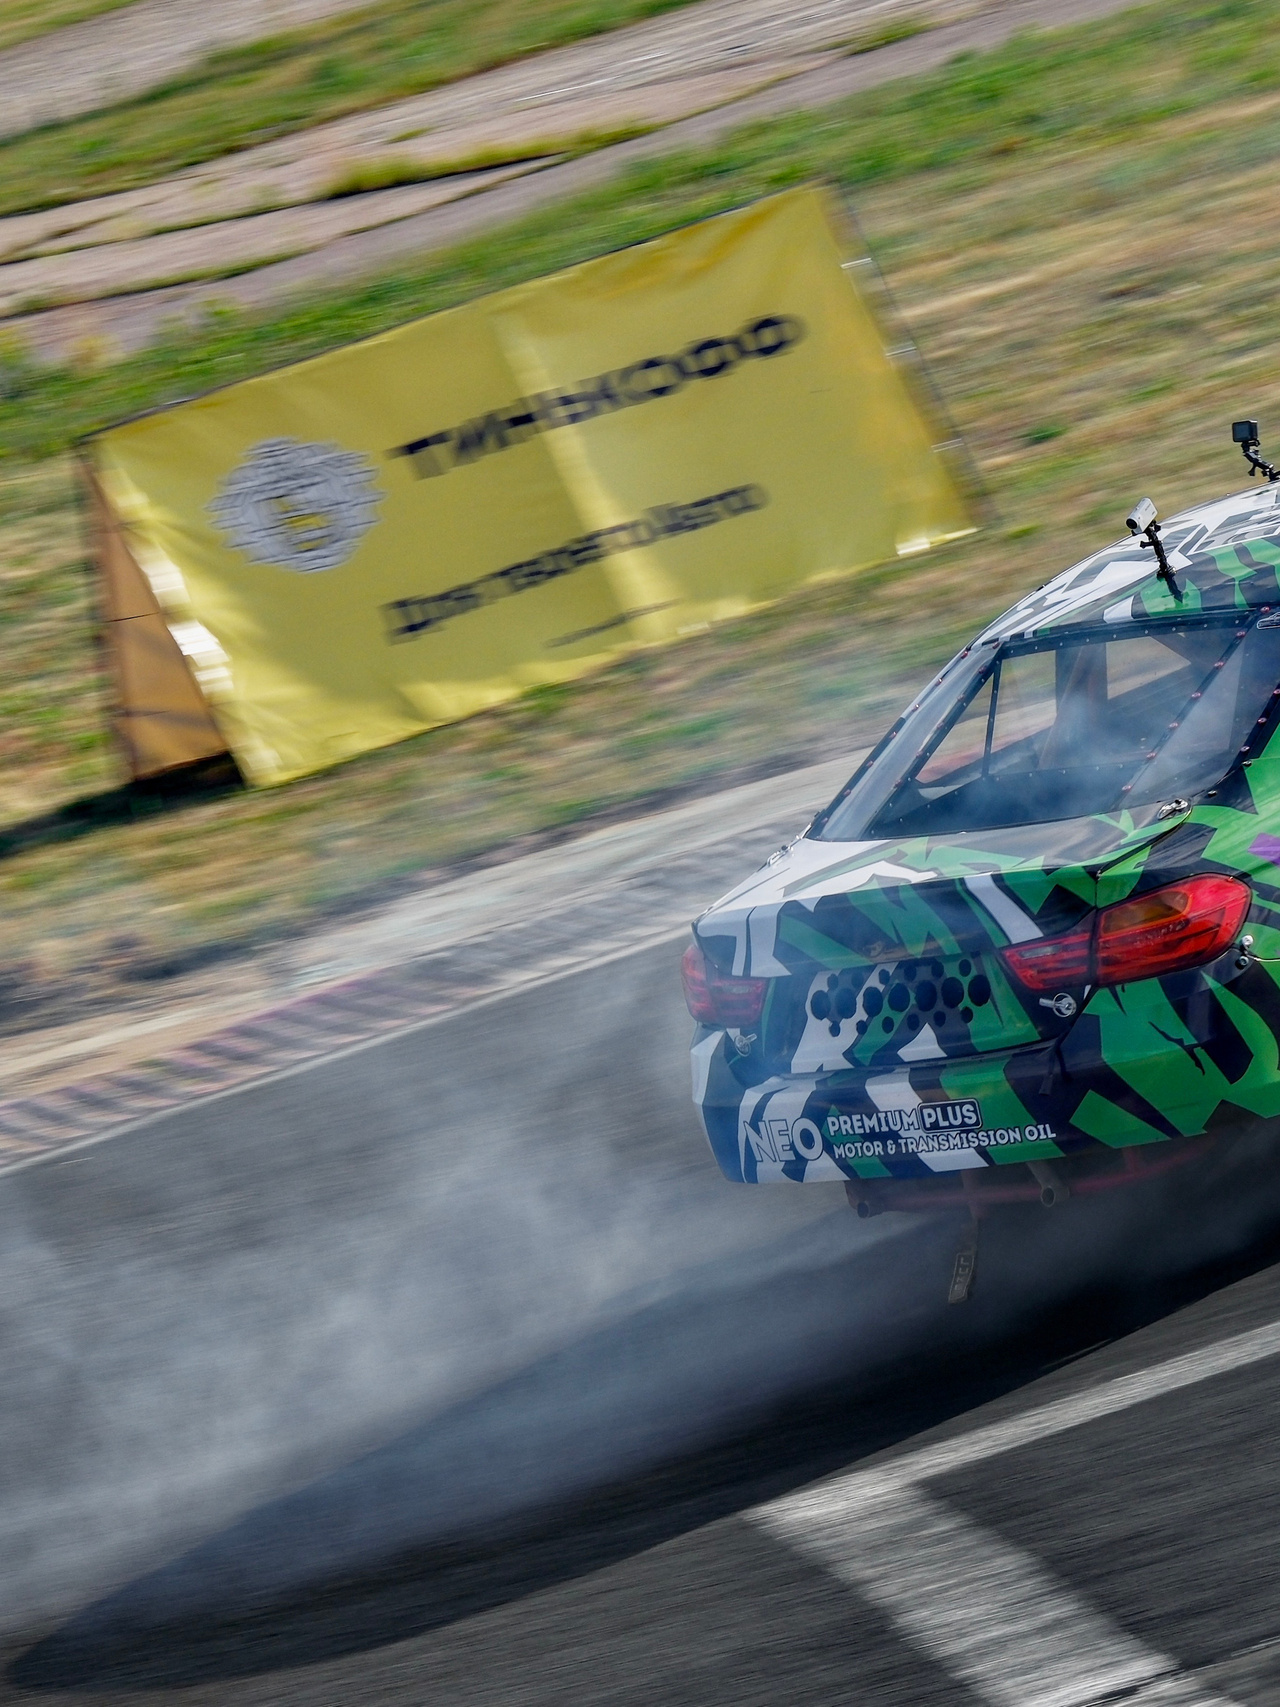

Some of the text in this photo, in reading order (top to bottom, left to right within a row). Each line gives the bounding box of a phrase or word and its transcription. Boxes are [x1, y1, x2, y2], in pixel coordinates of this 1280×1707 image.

[827, 1103, 977, 1137] PREMIUM PLUS
[743, 1117, 824, 1163] NEO
[832, 1123, 1057, 1160] MOTOR & TRANSMISSION OIL
